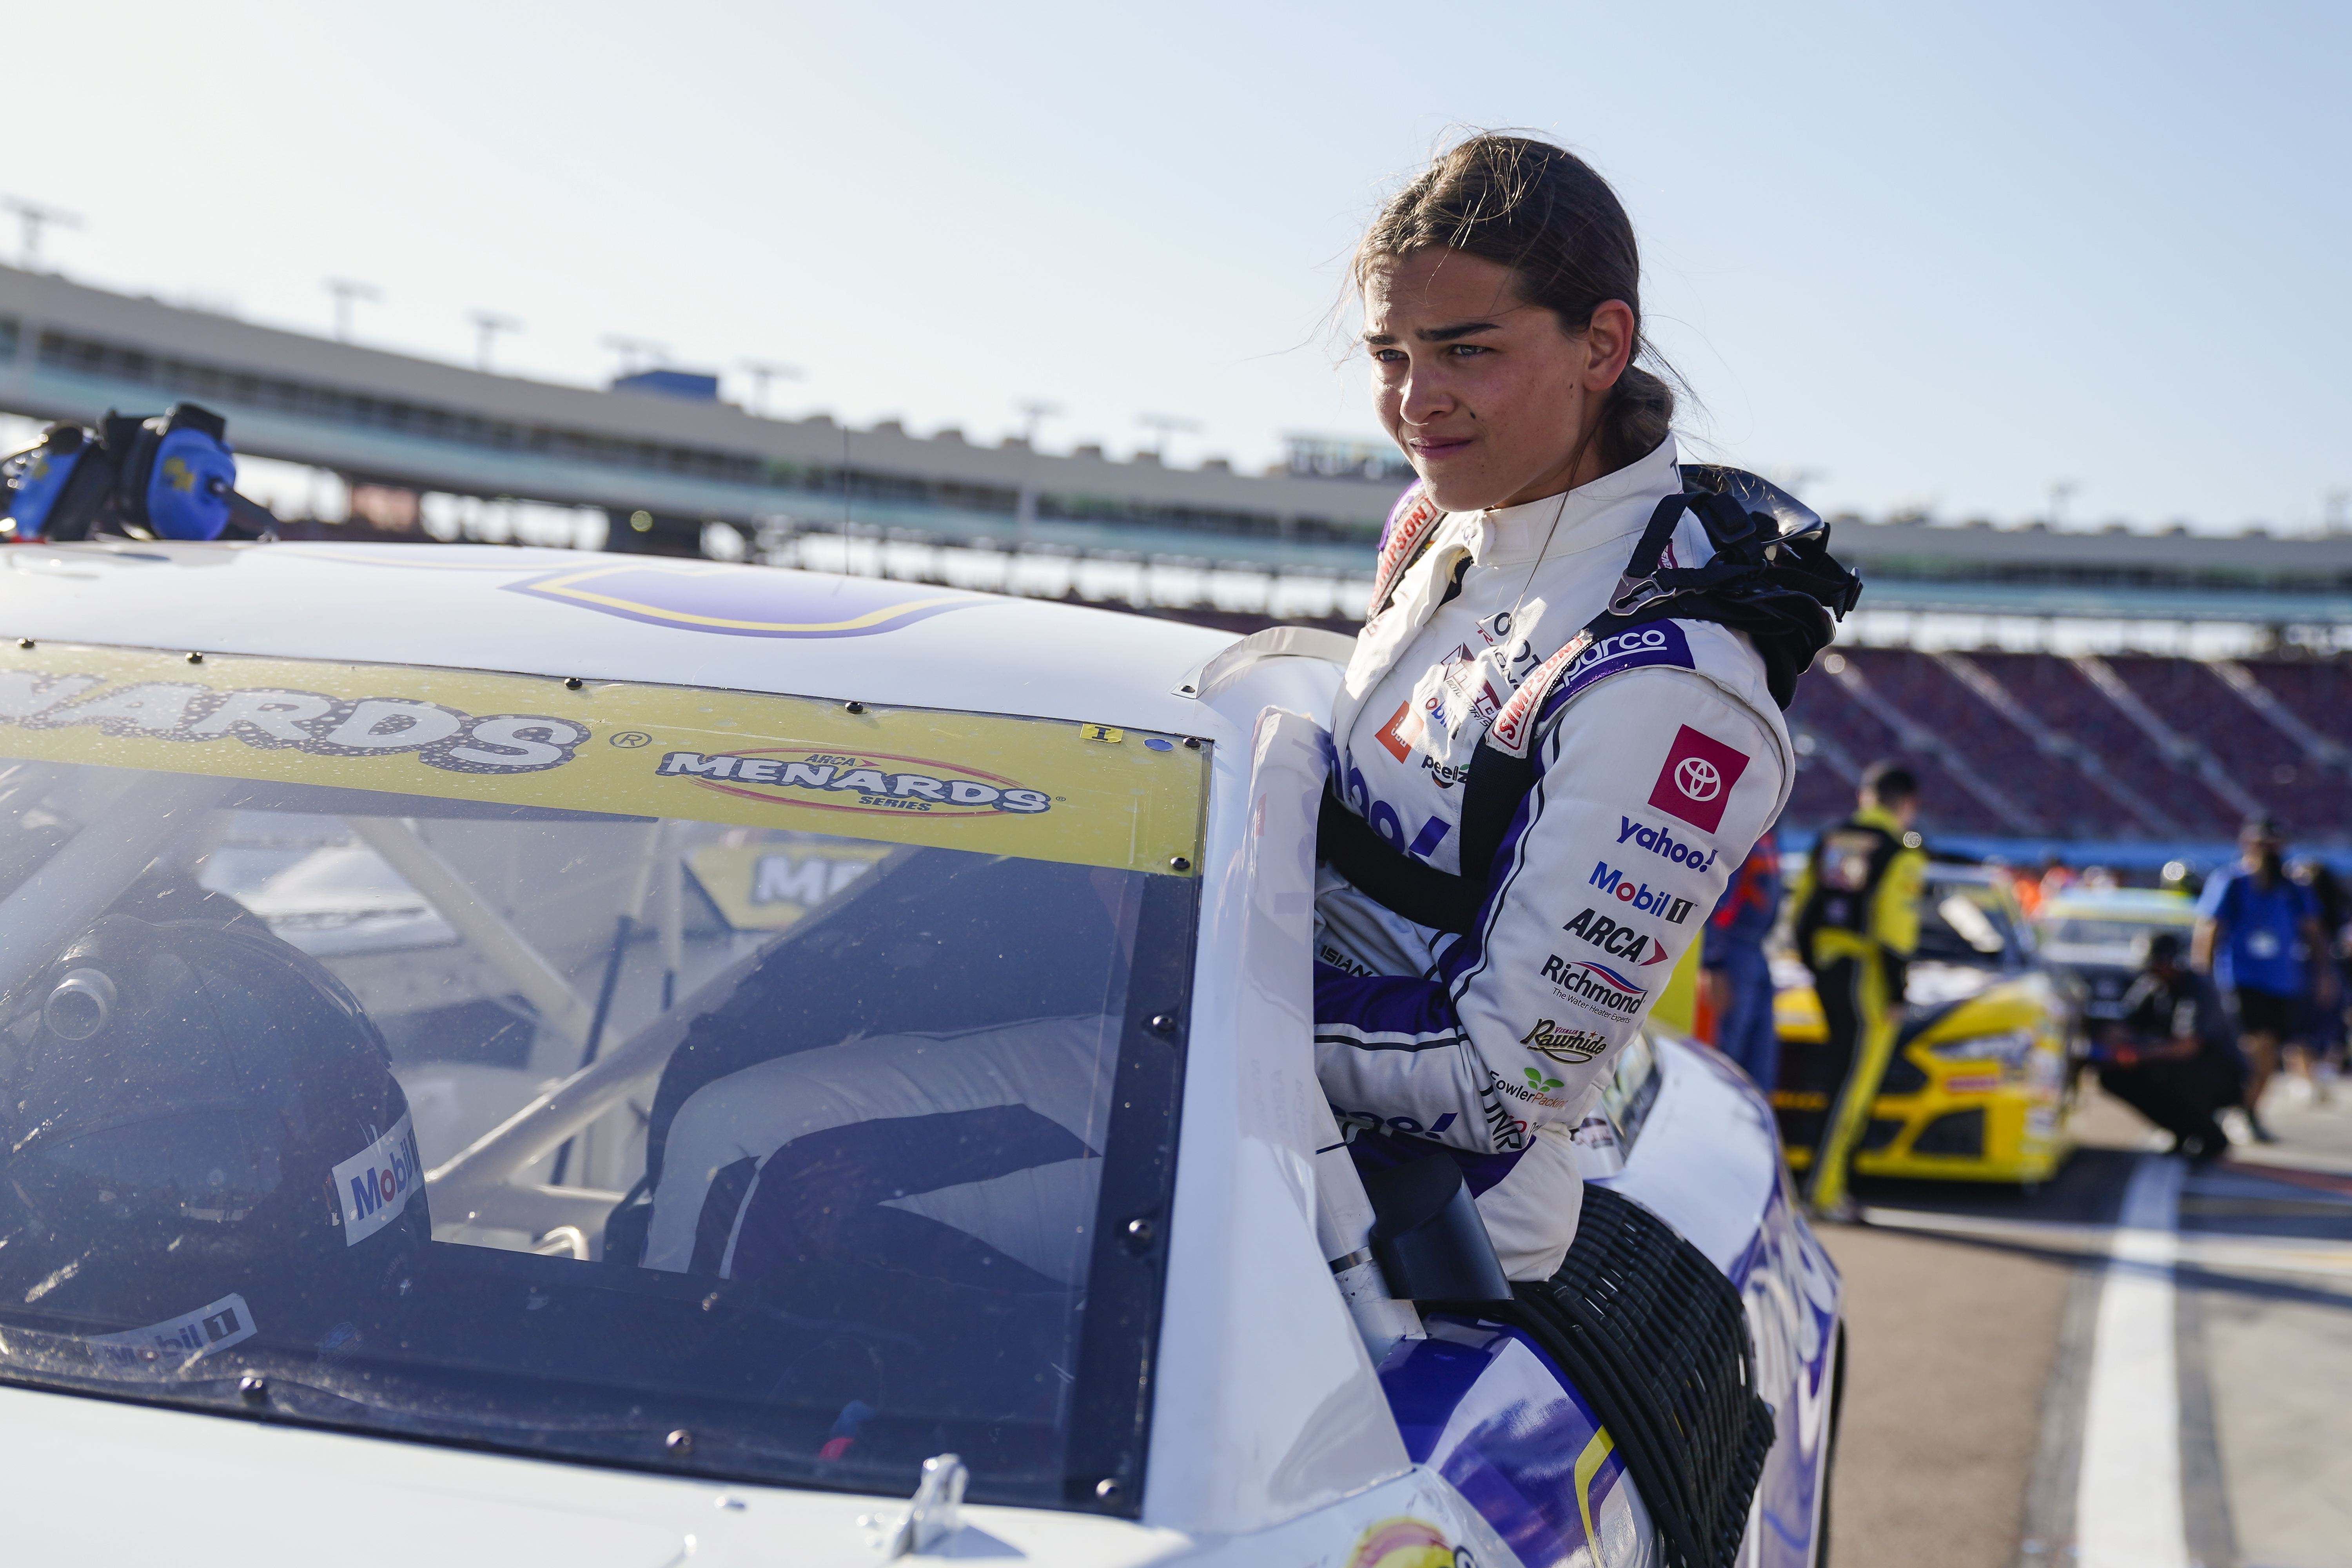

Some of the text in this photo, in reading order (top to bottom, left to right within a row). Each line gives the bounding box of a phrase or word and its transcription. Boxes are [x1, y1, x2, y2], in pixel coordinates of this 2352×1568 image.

[1499, 643, 1573, 740] SIMPSON
[655, 751, 1051, 814] MENARDS
[804, 753, 856, 767] ARCA
[858, 796, 932, 811] SERIES
[1616, 815, 1719, 873] yahoo!
[1588, 860, 1671, 917] Mobil
[1562, 907, 1650, 963] ARCA
[1540, 954, 1648, 1014] Richmond
[1552, 987, 1631, 1024] The Water Heater Experts
[1519, 1018, 1608, 1064] Rawhide
[350, 1138, 413, 1221] Mobil
[103, 1323, 203, 1367] Mobil
